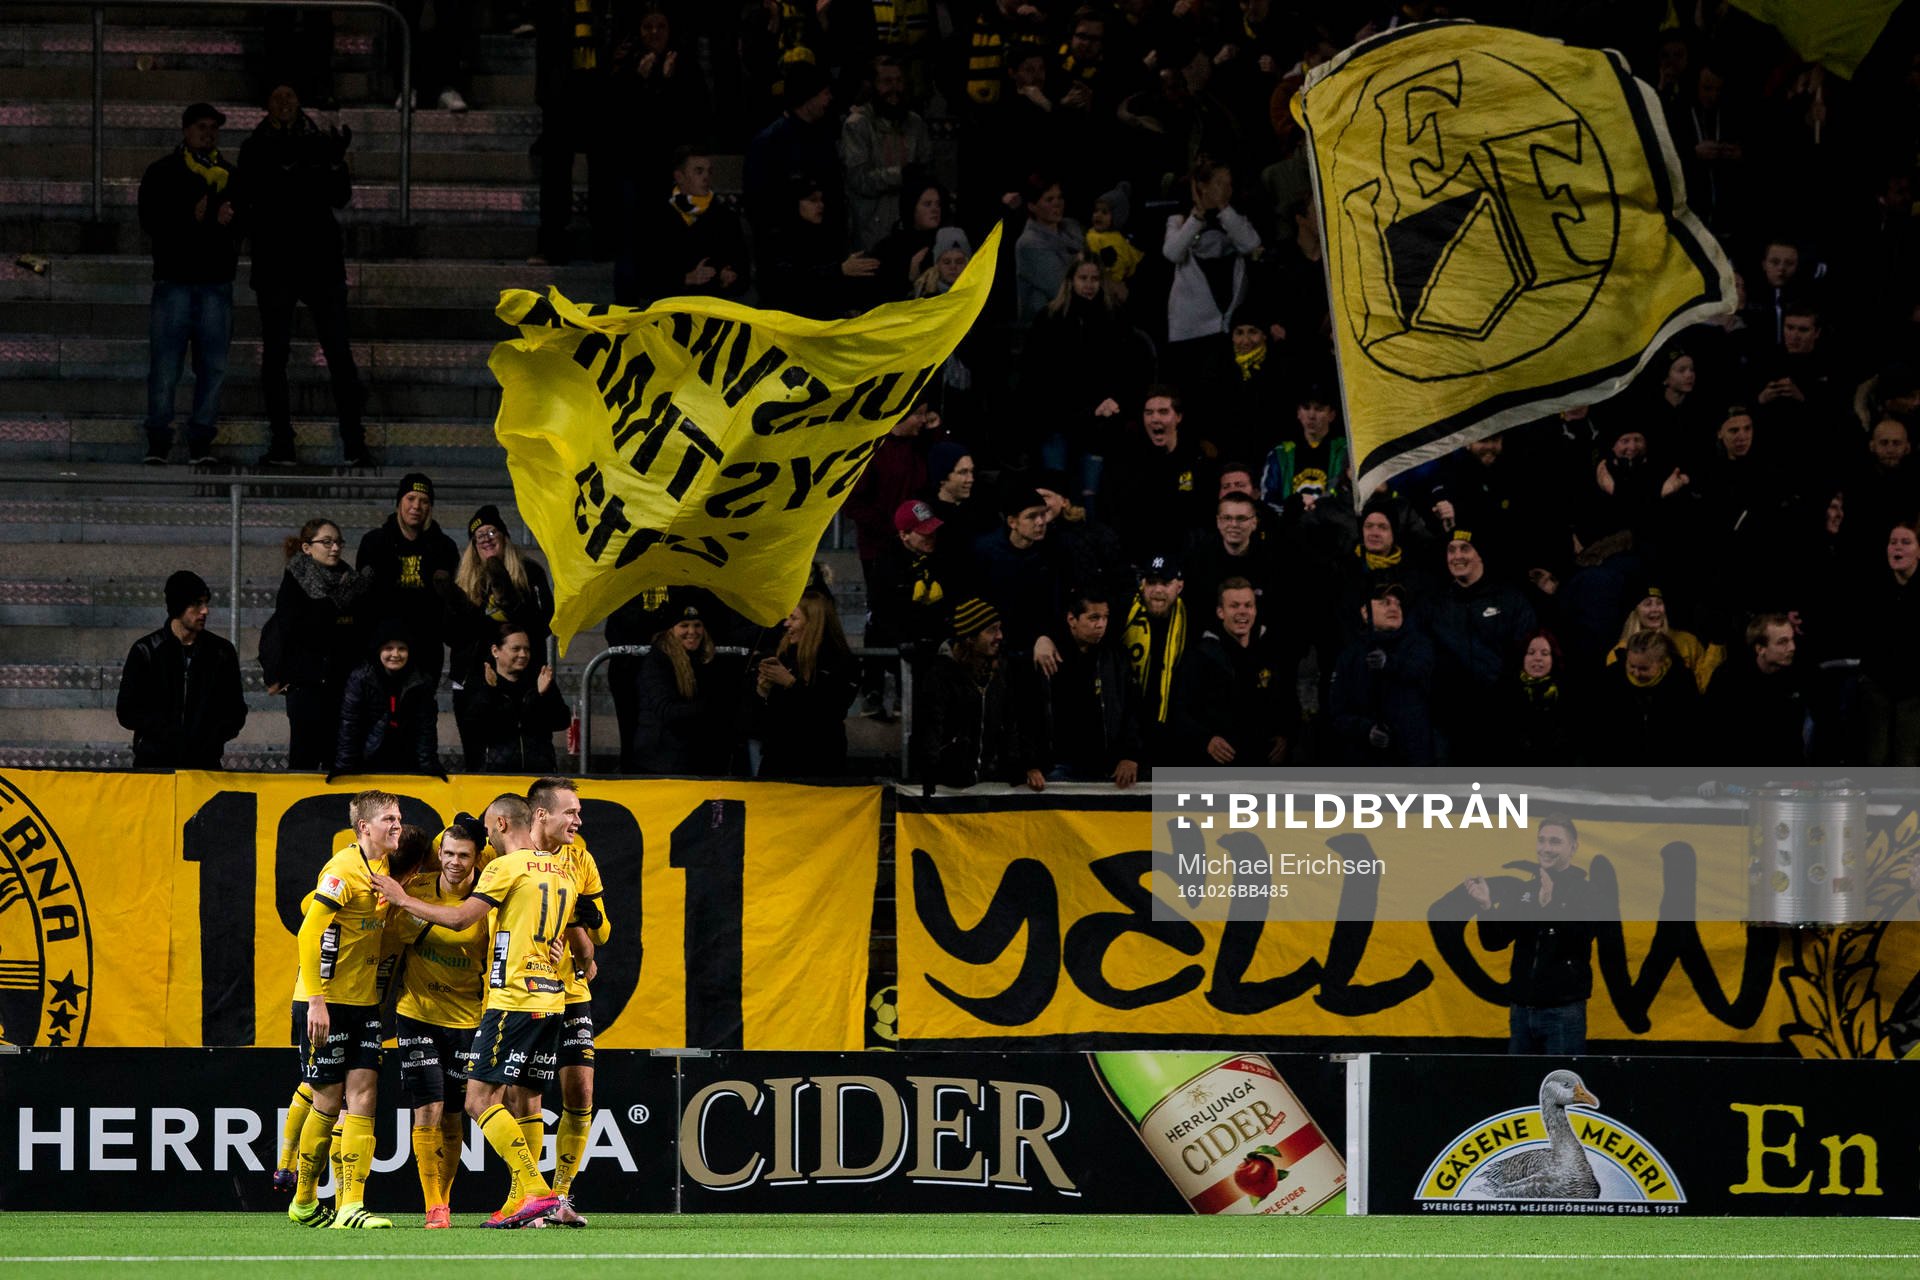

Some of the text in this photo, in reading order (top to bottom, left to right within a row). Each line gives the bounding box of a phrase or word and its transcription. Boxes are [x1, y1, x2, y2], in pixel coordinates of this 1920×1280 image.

[912, 820, 1776, 1036] YELLOW
[306, 1064, 319, 1078] 12
[681, 1074, 1082, 1197] CIDER
[1165, 1079, 1256, 1143] HERRLJUNGA
[1182, 1099, 1278, 1176] CIDER
[1729, 1102, 1884, 1196] En
[1436, 1118, 1666, 1194] GÄSENE MEJERI
[1422, 1203, 1473, 1211] SVERIGES
[1476, 1203, 1516, 1212] MINSTA
[1520, 1203, 1615, 1213] MEJERIFÖRENING
[1618, 1204, 1651, 1213] ETABL
